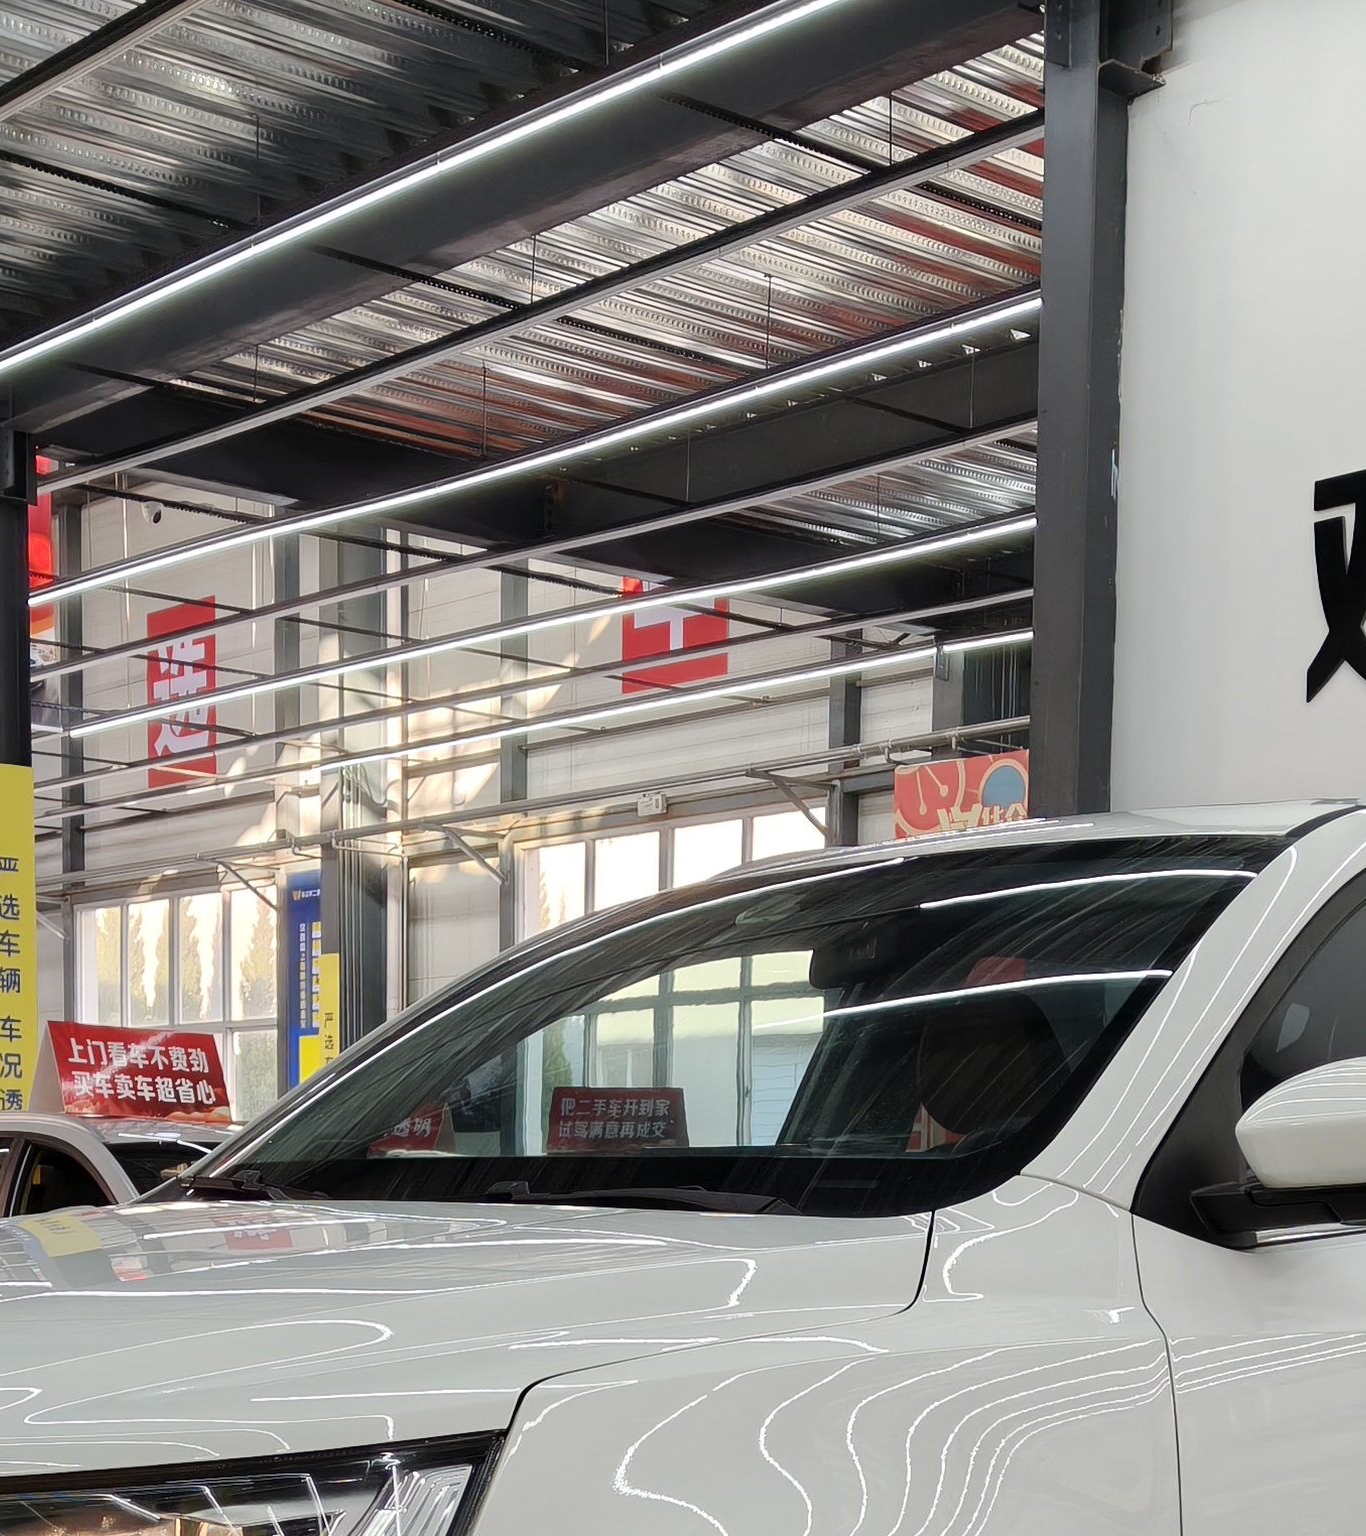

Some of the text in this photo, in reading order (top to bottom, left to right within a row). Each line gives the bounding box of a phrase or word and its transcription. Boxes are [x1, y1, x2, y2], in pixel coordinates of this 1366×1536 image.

[68, 1038, 209, 1073] 上门看车不费劲
[71, 1071, 216, 1105] 买车卖车超省心
[561, 1098, 670, 1118] 把二手车开到家
[559, 1120, 667, 1139] 试驾满意再成交
